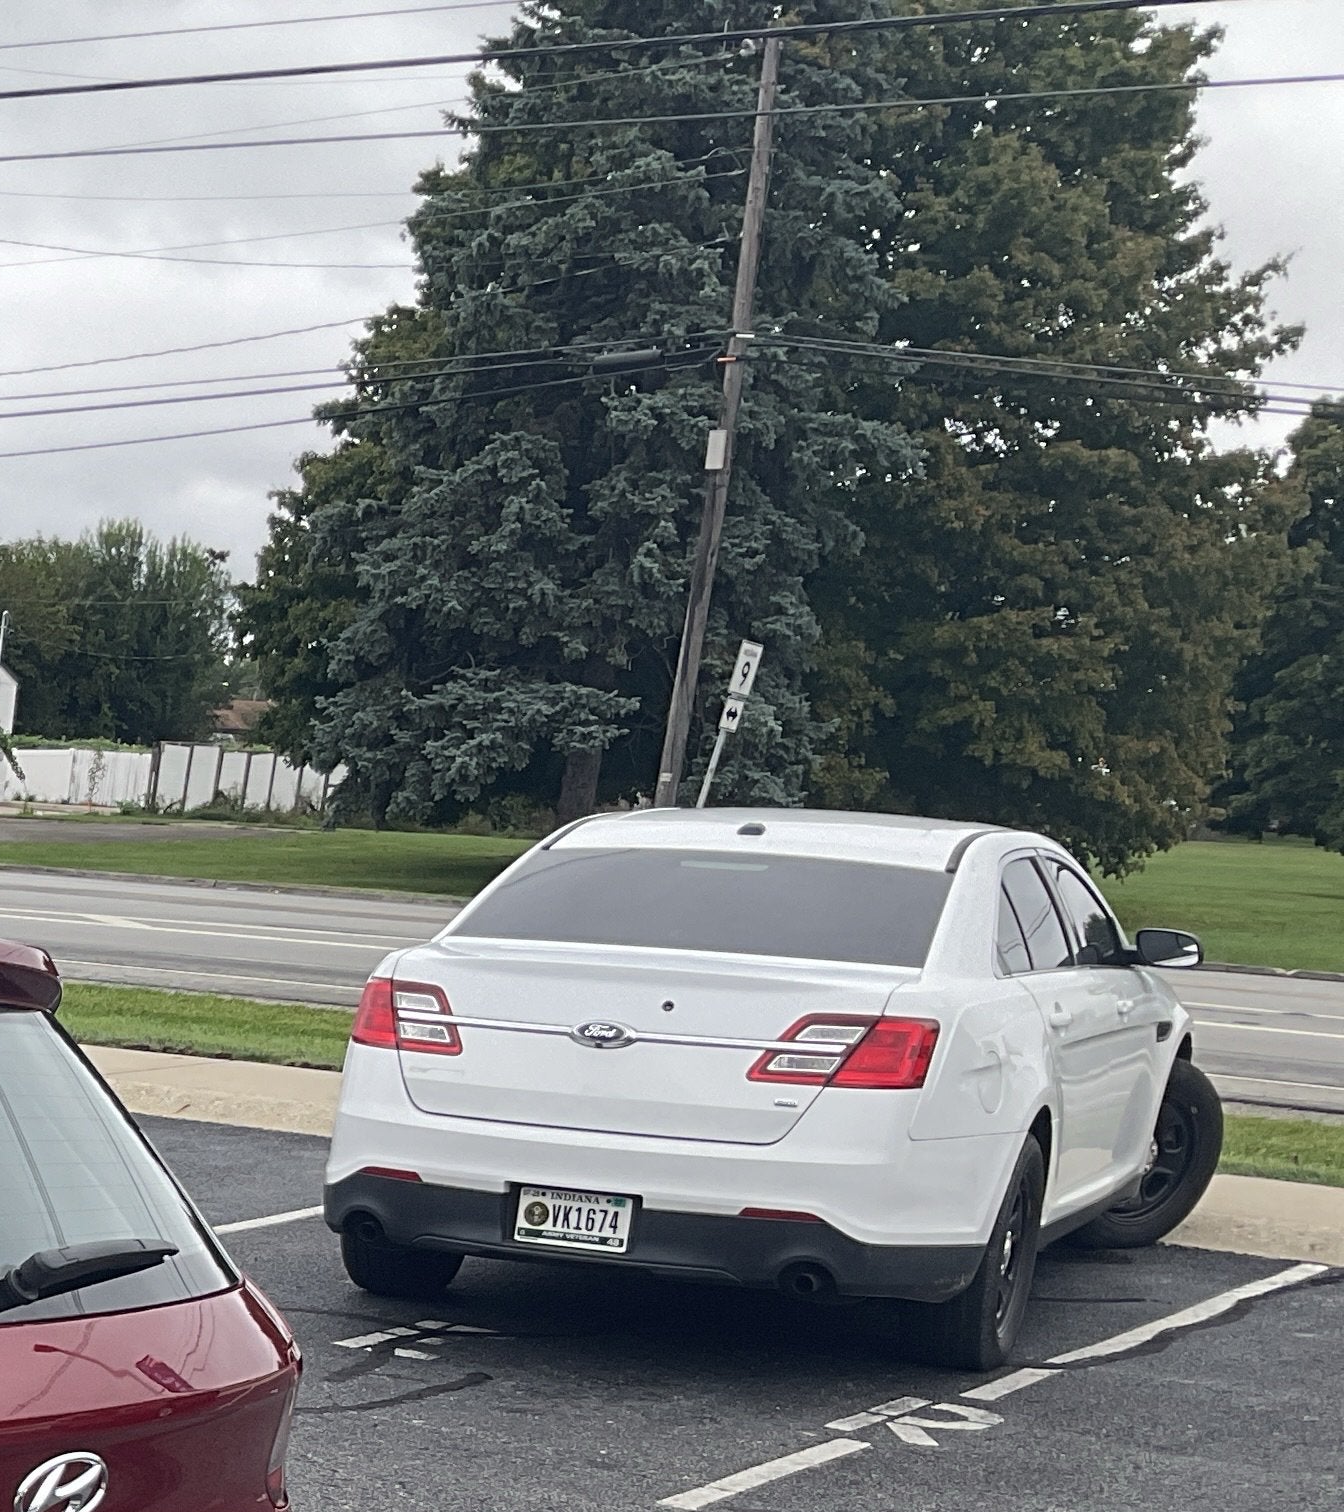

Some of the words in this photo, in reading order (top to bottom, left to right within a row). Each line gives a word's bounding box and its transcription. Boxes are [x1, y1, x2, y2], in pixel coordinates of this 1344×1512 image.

[739, 661, 751, 687] 9
[584, 1023, 618, 1038] Ford
[550, 1191, 600, 1204] INDIANA
[552, 1204, 619, 1234] VK1674
